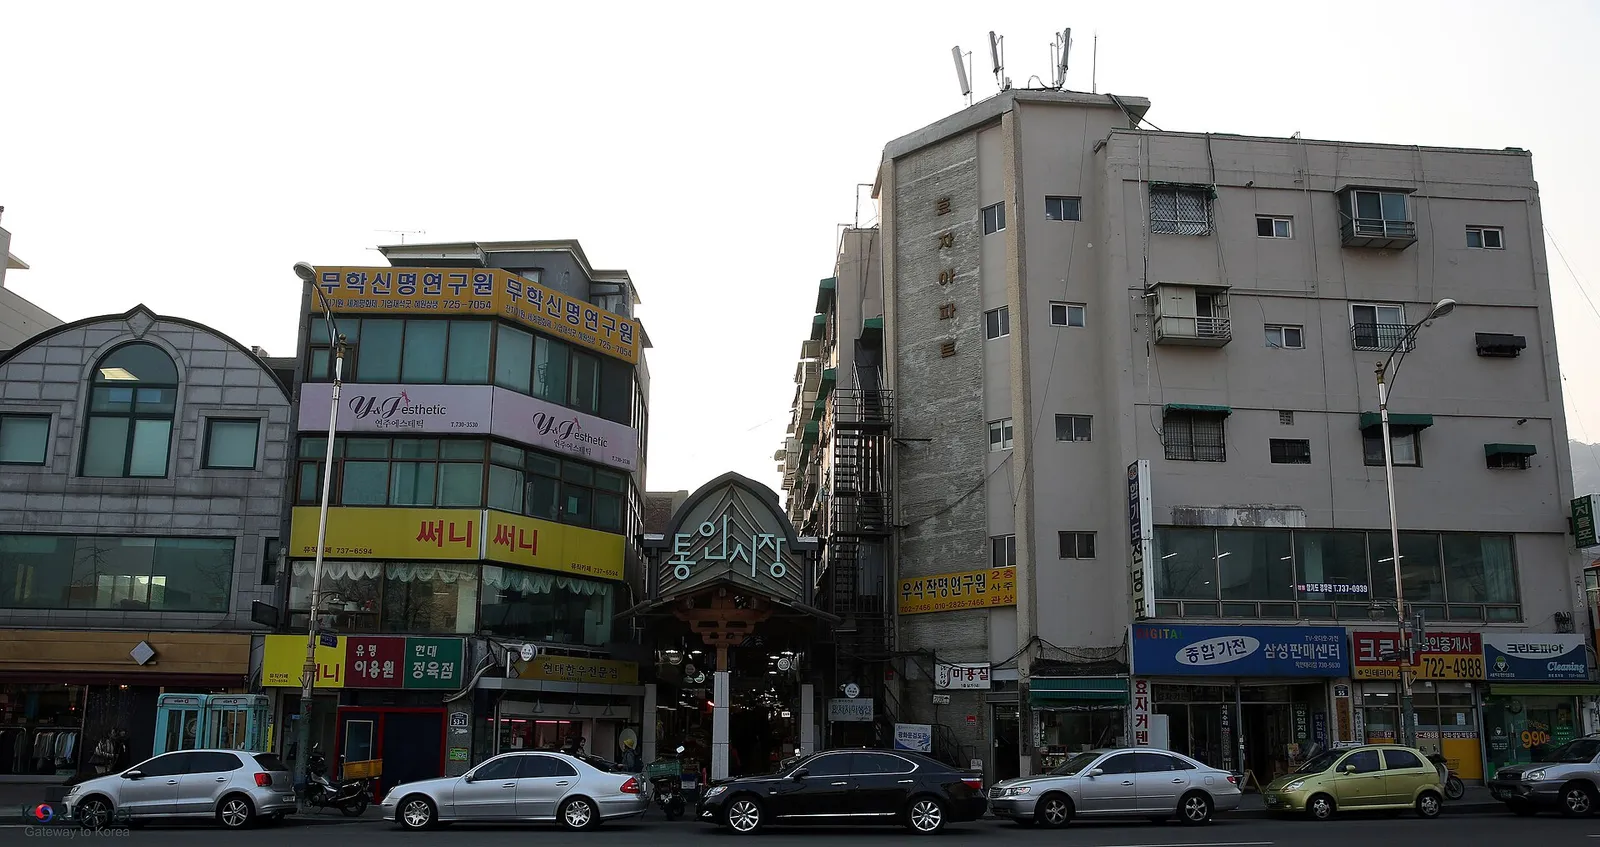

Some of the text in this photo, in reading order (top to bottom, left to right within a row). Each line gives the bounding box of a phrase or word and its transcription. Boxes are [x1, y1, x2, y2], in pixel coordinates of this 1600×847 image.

[320, 272, 493, 296] 무학신명연구원
[937, 197, 956, 358] 효자아파트
[443, 300, 492, 310] 725-7054
[506, 278, 634, 345] 무학신명연구원
[598, 338, 633, 358] 725-7054
[401, 404, 447, 415] esthetic
[574, 432, 608, 448] esthetic
[1130, 481, 1141, 541] 합기도
[416, 519, 473, 548] 써니
[492, 523, 538, 556] 써니
[303, 546, 373, 555] 뮤직페 737-6594
[668, 514, 786, 580] 통인시장
[991, 569, 1014, 580] 2층
[1132, 543, 1146, 621] 전당포
[901, 573, 987, 602] 우석 작명연구원
[990, 581, 1014, 592] 사주
[934, 598, 985, 610] 010-2825-7466
[990, 594, 1014, 605] 관상
[1136, 627, 1184, 640] DIGITAL
[356, 644, 377, 657] 유명
[415, 644, 438, 657] 현대
[1263, 643, 1340, 660] 삼성판매센터
[1506, 643, 1564, 654] 크린토피아
[315, 663, 340, 683] 니
[354, 660, 395, 679] 이용원
[412, 661, 454, 680] 정육점
[543, 662, 619, 679] 현대한우전문점
[953, 667, 989, 682] 미용실
[1364, 668, 1394, 678] 인테리어
[1422, 657, 1483, 678] 722-4988
[1546, 661, 1585, 673] Cleaning
[1135, 680, 1149, 746] 효자커텐
